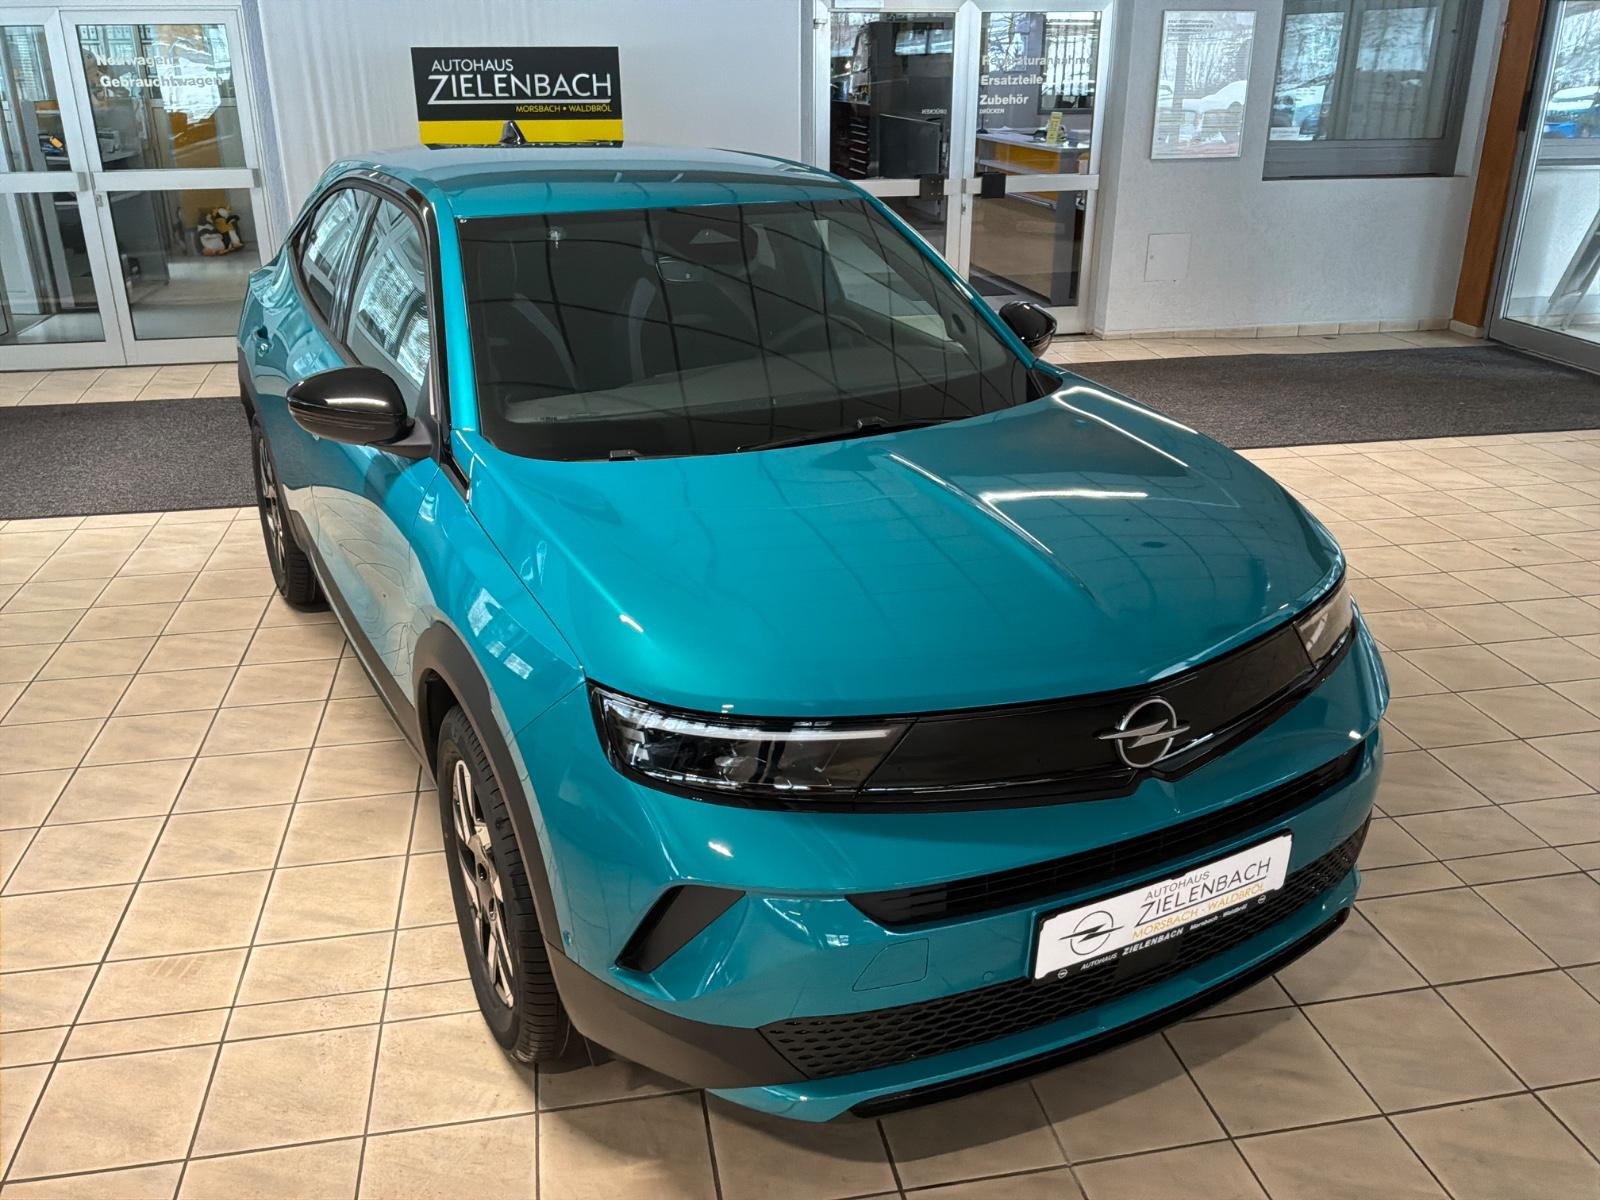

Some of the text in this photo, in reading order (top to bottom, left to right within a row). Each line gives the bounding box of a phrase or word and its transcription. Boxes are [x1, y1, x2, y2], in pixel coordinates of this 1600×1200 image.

[431, 58, 514, 72] AUTOHAUS
[980, 74, 1044, 86] Ersatzteile
[427, 73, 612, 104] ZIELENBACH
[979, 94, 1029, 105] Zubehör
[515, 104, 612, 113] MORSBACH WALDBRÖL
[1133, 857, 1272, 928] ZIELENBACH
[1144, 870, 1210, 901] AUTOHAUS
[1131, 882, 1265, 939] MORSBACH WALDBRÖL
[1080, 953, 1118, 971] AUTOHAUS
[1122, 927, 1184, 957] ZIELENBACH
